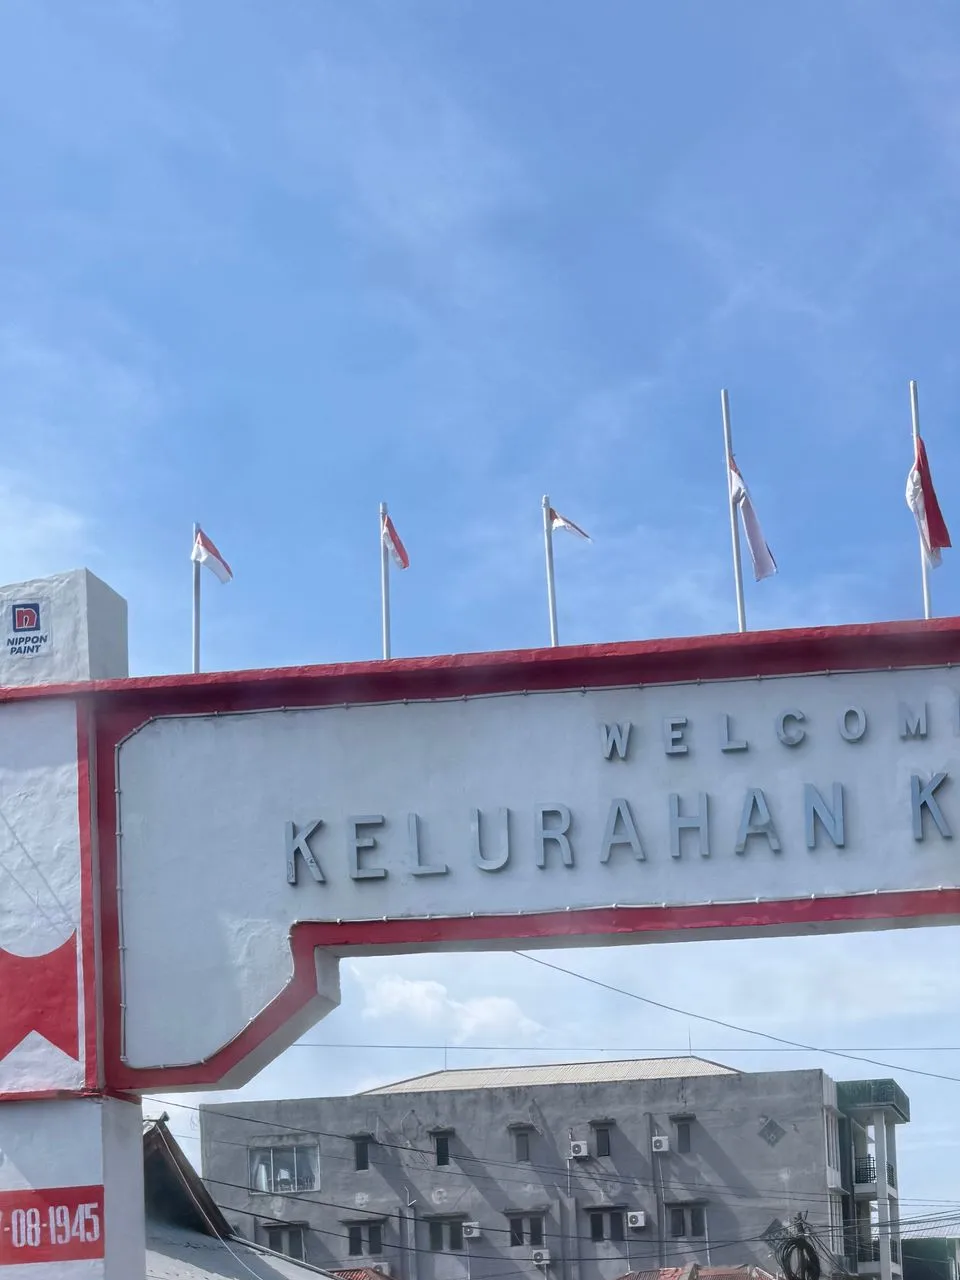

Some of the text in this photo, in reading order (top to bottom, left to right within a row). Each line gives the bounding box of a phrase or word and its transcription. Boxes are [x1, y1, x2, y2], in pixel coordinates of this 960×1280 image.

[6, 634, 48, 647] NIPPON
[10, 644, 42, 656] PAINT
[284, 782, 846, 885] KELURAHAN
[0, 1202, 100, 1248] -08-1945
